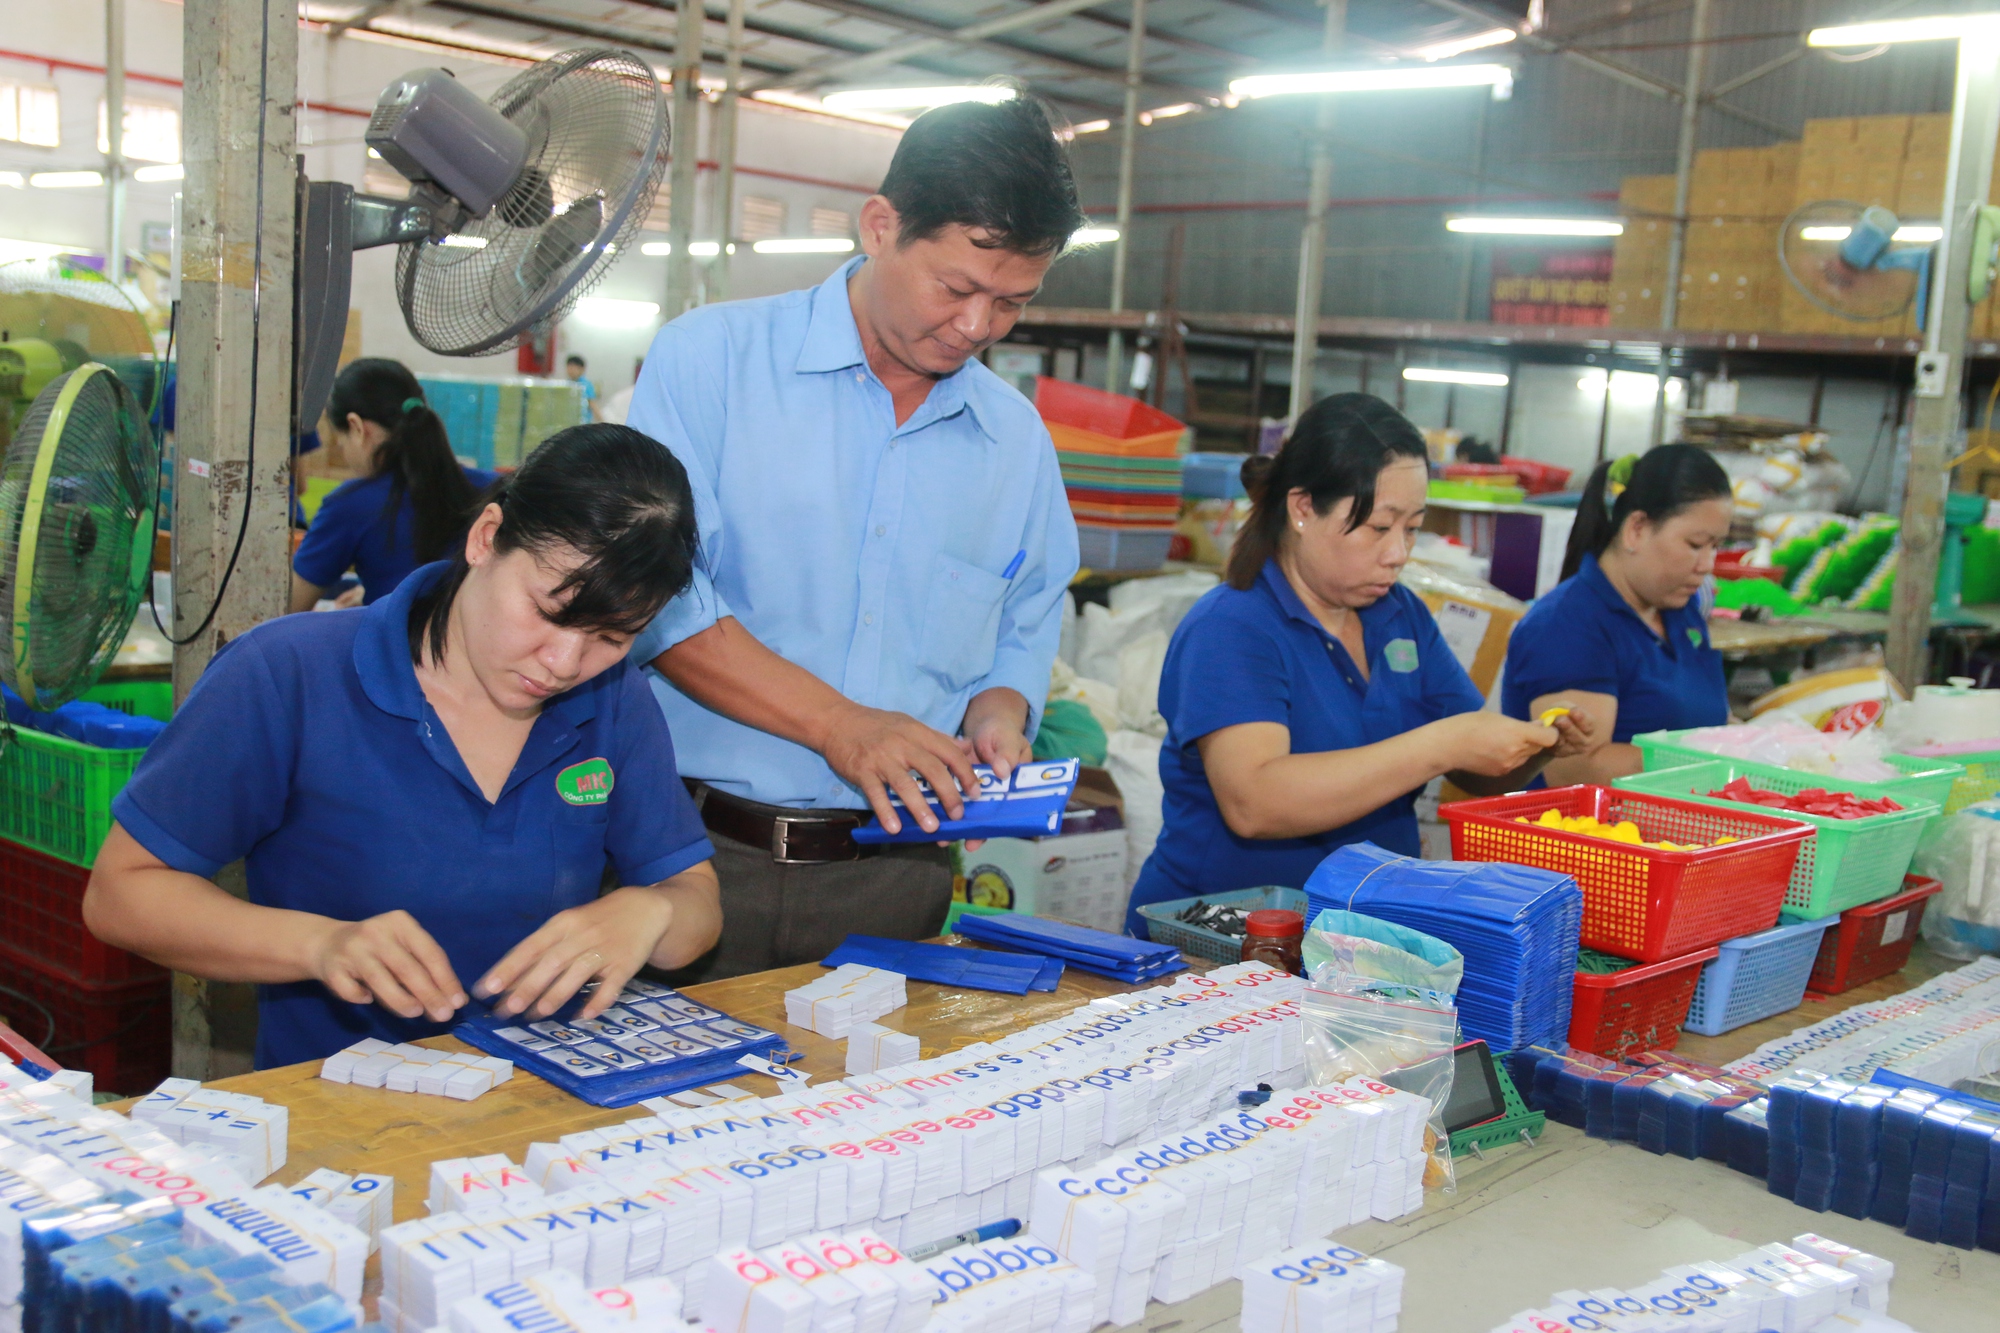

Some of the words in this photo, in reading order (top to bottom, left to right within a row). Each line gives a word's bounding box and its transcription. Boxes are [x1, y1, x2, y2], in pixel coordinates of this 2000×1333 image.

[819, 1239, 865, 1268] â
[859, 1236, 904, 1265] â
[982, 1248, 1028, 1273] b
[1013, 1244, 1059, 1266] b
[730, 1252, 779, 1283] ă
[782, 1250, 826, 1279] â
[951, 1256, 998, 1282] b
[926, 1268, 973, 1293] b
